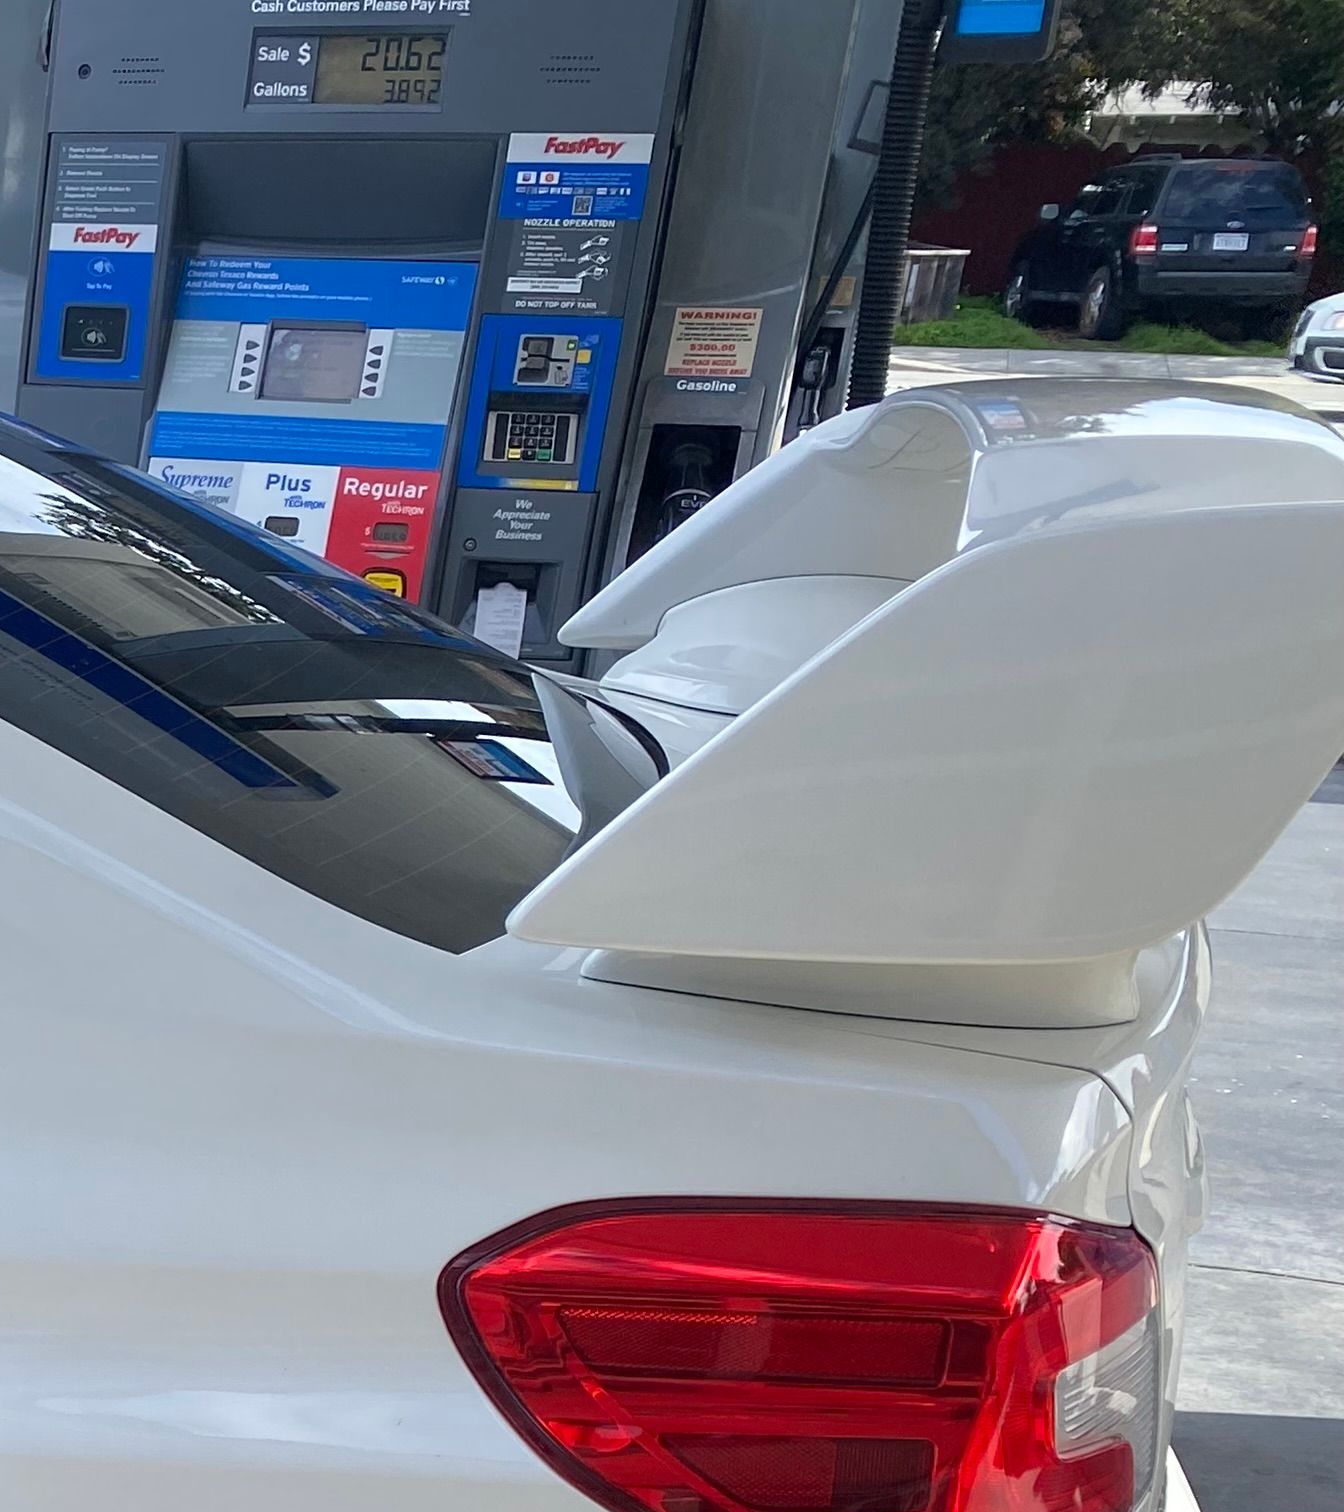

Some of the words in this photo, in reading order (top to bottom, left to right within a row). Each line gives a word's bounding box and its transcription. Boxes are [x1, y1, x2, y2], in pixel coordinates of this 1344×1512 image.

[251, 1, 284, 13] Cash
[287, 0, 360, 12] Customers
[363, 0, 408, 11] Please
[411, 0, 435, 14] Pay
[438, 0, 470, 11] First
[257, 46, 289, 62] Sale
[297, 42, 311, 66] $
[361, 37, 447, 72] 20.62
[253, 81, 308, 98] Gallons
[544, 137, 628, 160] FastPay
[523, 218, 561, 227] NOZZLE
[562, 218, 616, 228] OPERATION
[73, 226, 141, 249] FastPay
[515, 300, 526, 308] DO
[544, 301, 560, 309] TOP
[560, 301, 575, 309] OFF
[680, 311, 758, 321] WARNING!
[676, 379, 737, 392] Gasoline
[161, 464, 234, 490] Supreme
[265, 473, 312, 492] Plus
[343, 477, 429, 500] Regular
[284, 498, 326, 510] TECHRON
[515, 499, 533, 509] We
[493, 508, 551, 520] Appreciate
[509, 519, 534, 530] Your
[495, 529, 542, 540] Business
